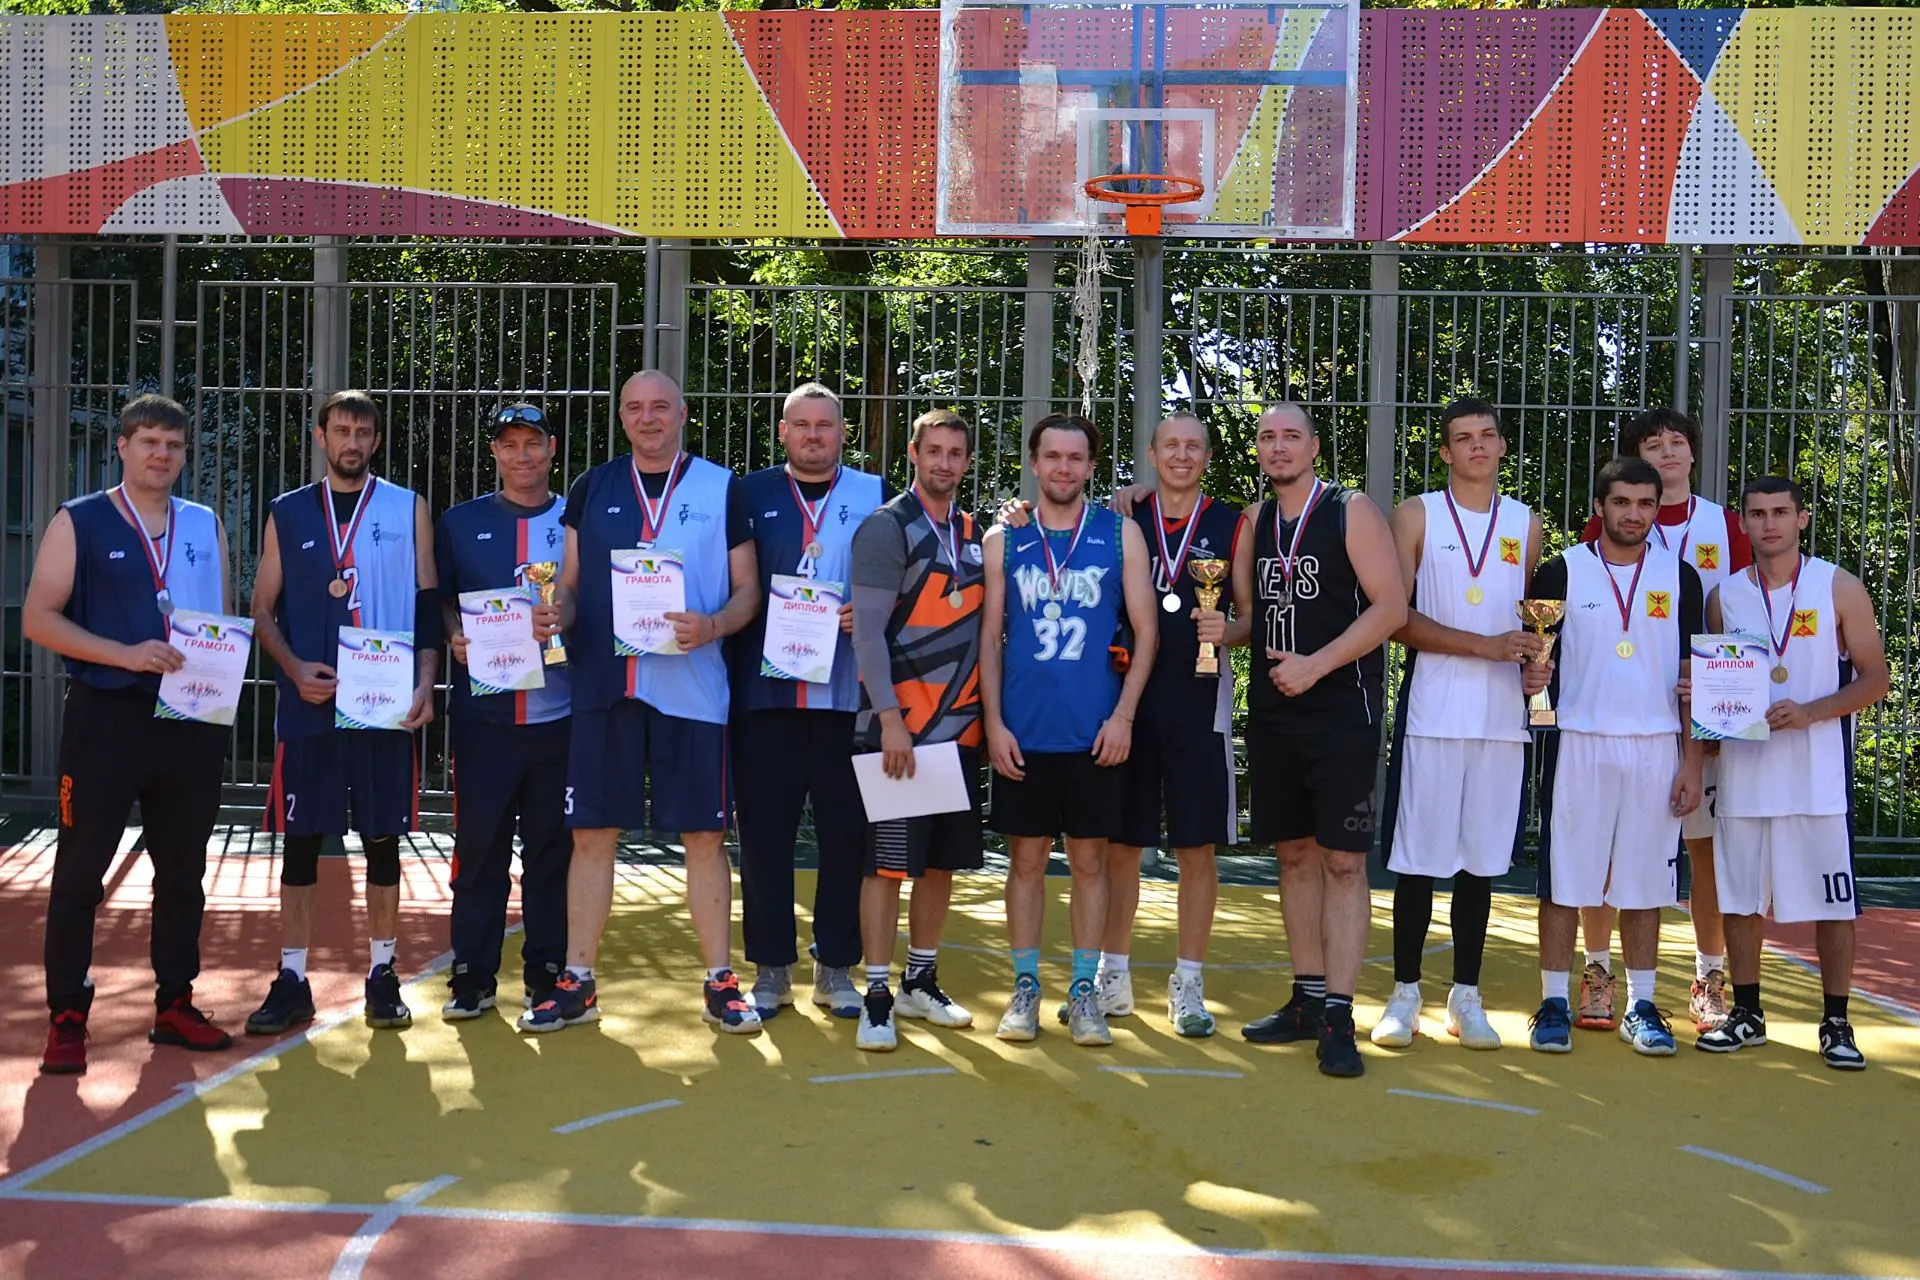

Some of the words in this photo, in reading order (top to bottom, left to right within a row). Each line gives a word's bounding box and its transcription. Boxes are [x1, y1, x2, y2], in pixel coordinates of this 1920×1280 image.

[796, 552, 817, 581] 4
[343, 567, 362, 611] 2
[625, 575, 672, 585] ГРАМОТА
[783, 600, 828, 614] ДИПЛОМ
[476, 612, 523, 626] ГРАМОТА
[184, 638, 236, 653] ГРАМОТА
[1031, 616, 1087, 661] 32
[351, 652, 400, 664] ГРАМОТА
[1706, 659, 1755, 671] ДИПЛОМ
[286, 793, 296, 822] 2
[564, 786, 575, 815] 3
[1822, 872, 1853, 904] 10
